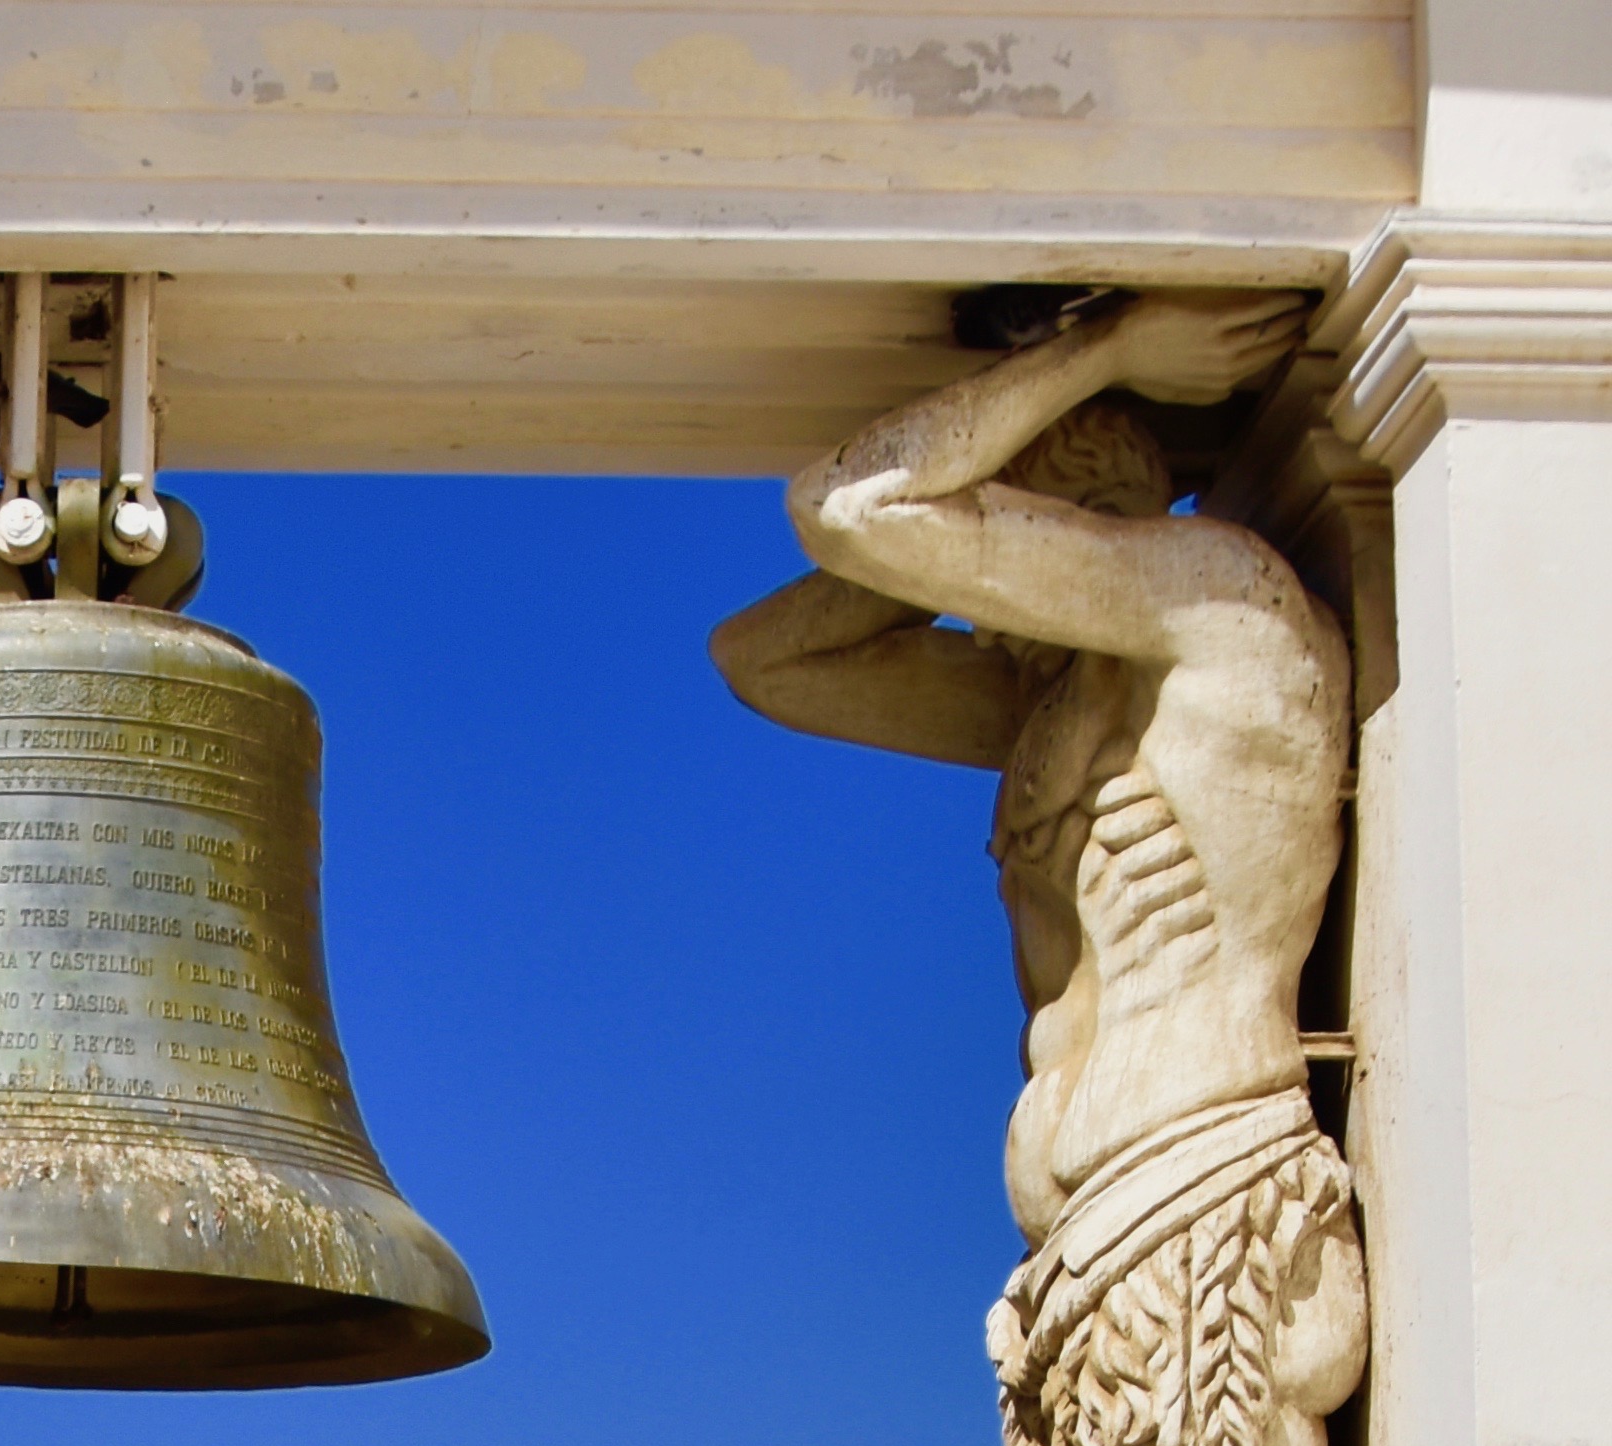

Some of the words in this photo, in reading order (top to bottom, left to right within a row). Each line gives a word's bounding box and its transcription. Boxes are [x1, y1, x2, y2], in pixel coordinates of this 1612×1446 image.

[19, 728, 127, 751] FESTIVIDAD
[91, 822, 129, 845] CON
[140, 828, 175, 850] MIS
[131, 869, 196, 897] QUIERO
[19, 907, 70, 928] TRES
[86, 909, 183, 939] PRIMEROS
[27, 949, 42, 970] Y
[48, 949, 154, 976] CASTELLON
[190, 963, 211, 984] EL
[216, 967, 239, 990] DE
[31, 990, 45, 1010] Y
[52, 993, 129, 1015] LOASIGA
[161, 1001, 184, 1020] EL
[192, 1004, 213, 1025] DE
[219, 1009, 248, 1031] LOS
[73, 1034, 136, 1056] REYES
[168, 1042, 190, 1062] EL
[198, 1046, 220, 1066] DE
[227, 1050, 258, 1073] LAS
